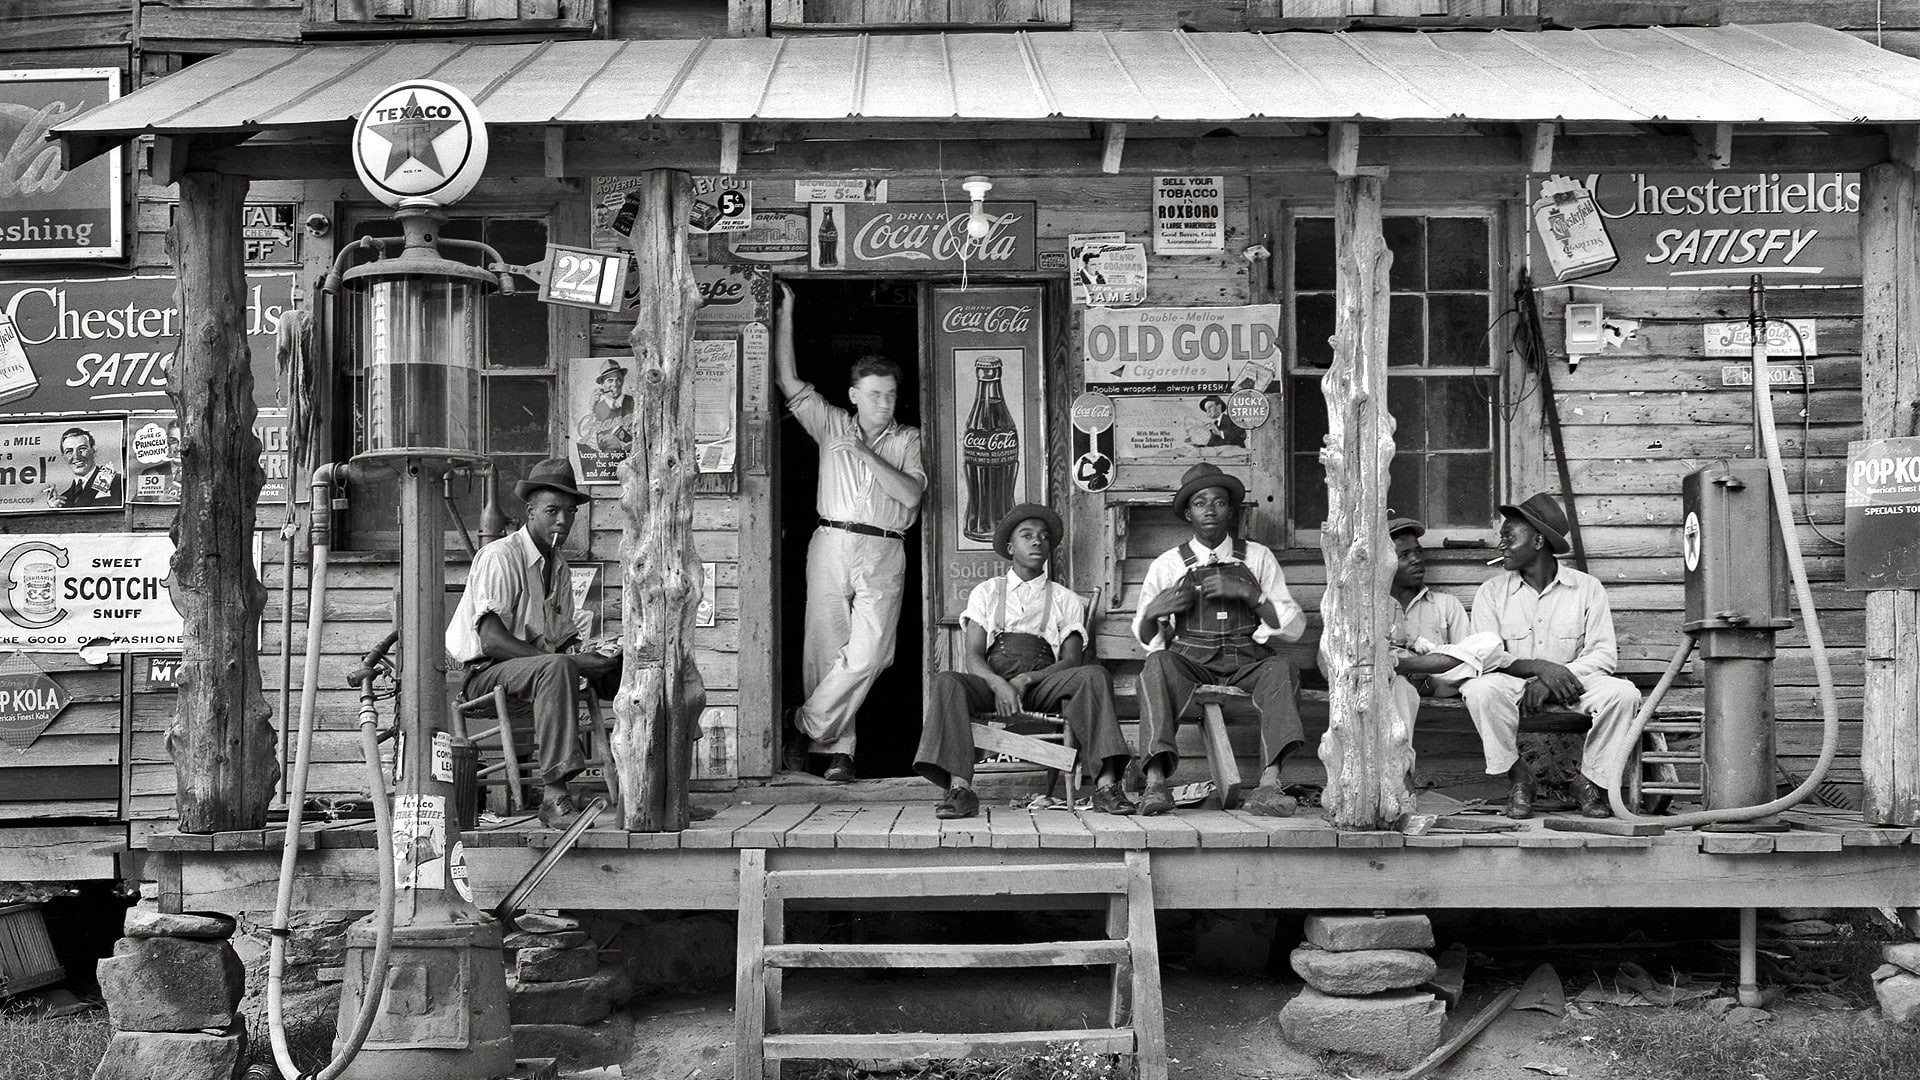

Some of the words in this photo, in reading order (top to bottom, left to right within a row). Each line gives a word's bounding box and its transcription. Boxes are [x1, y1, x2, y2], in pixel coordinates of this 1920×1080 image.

[376, 105, 452, 121] TEXACO
[1162, 178, 1186, 186] SELL
[1188, 177, 1214, 186] YOUR
[1158, 188, 1218, 198] TOBACCO
[897, 212, 947, 221] DRINK
[1158, 205, 1219, 219] ROXBORO
[755, 214, 788, 222] DRINK
[245, 229, 273, 238] CHEW
[853, 211, 1023, 262] Coca-Cola
[1646, 228, 1819, 265] SATISFY
[552, 255, 602, 290] 22
[942, 305, 1032, 333] Coca-Cola
[1140, 312, 1225, 323] Double-Mellow
[1088, 324, 1164, 362] OLD
[1172, 323, 1277, 362] GOLD
[1133, 365, 1207, 380] Cigarettes
[1092, 385, 1120, 393] Double
[1166, 384, 1195, 393] always
[1197, 383, 1229, 393] FRESH!
[1233, 397, 1263, 406] LUCKY
[1231, 407, 1266, 416] STRIKE
[13, 436, 41, 447] MILE
[135, 439, 166, 450] PRINCELY
[964, 430, 1018, 450] Coca-Cola
[145, 476, 160, 485] 50
[1864, 506, 1904, 516] SPECIALS
[91, 558, 142, 568] SWEET
[950, 561, 988, 578] Sold
[64, 576, 158, 601] SCOTCH
[93, 608, 143, 619] SNUFF
[28, 635, 67, 644] GOOD
[12, 687, 60, 712] KOLA
[35, 712, 49, 721] Kola
